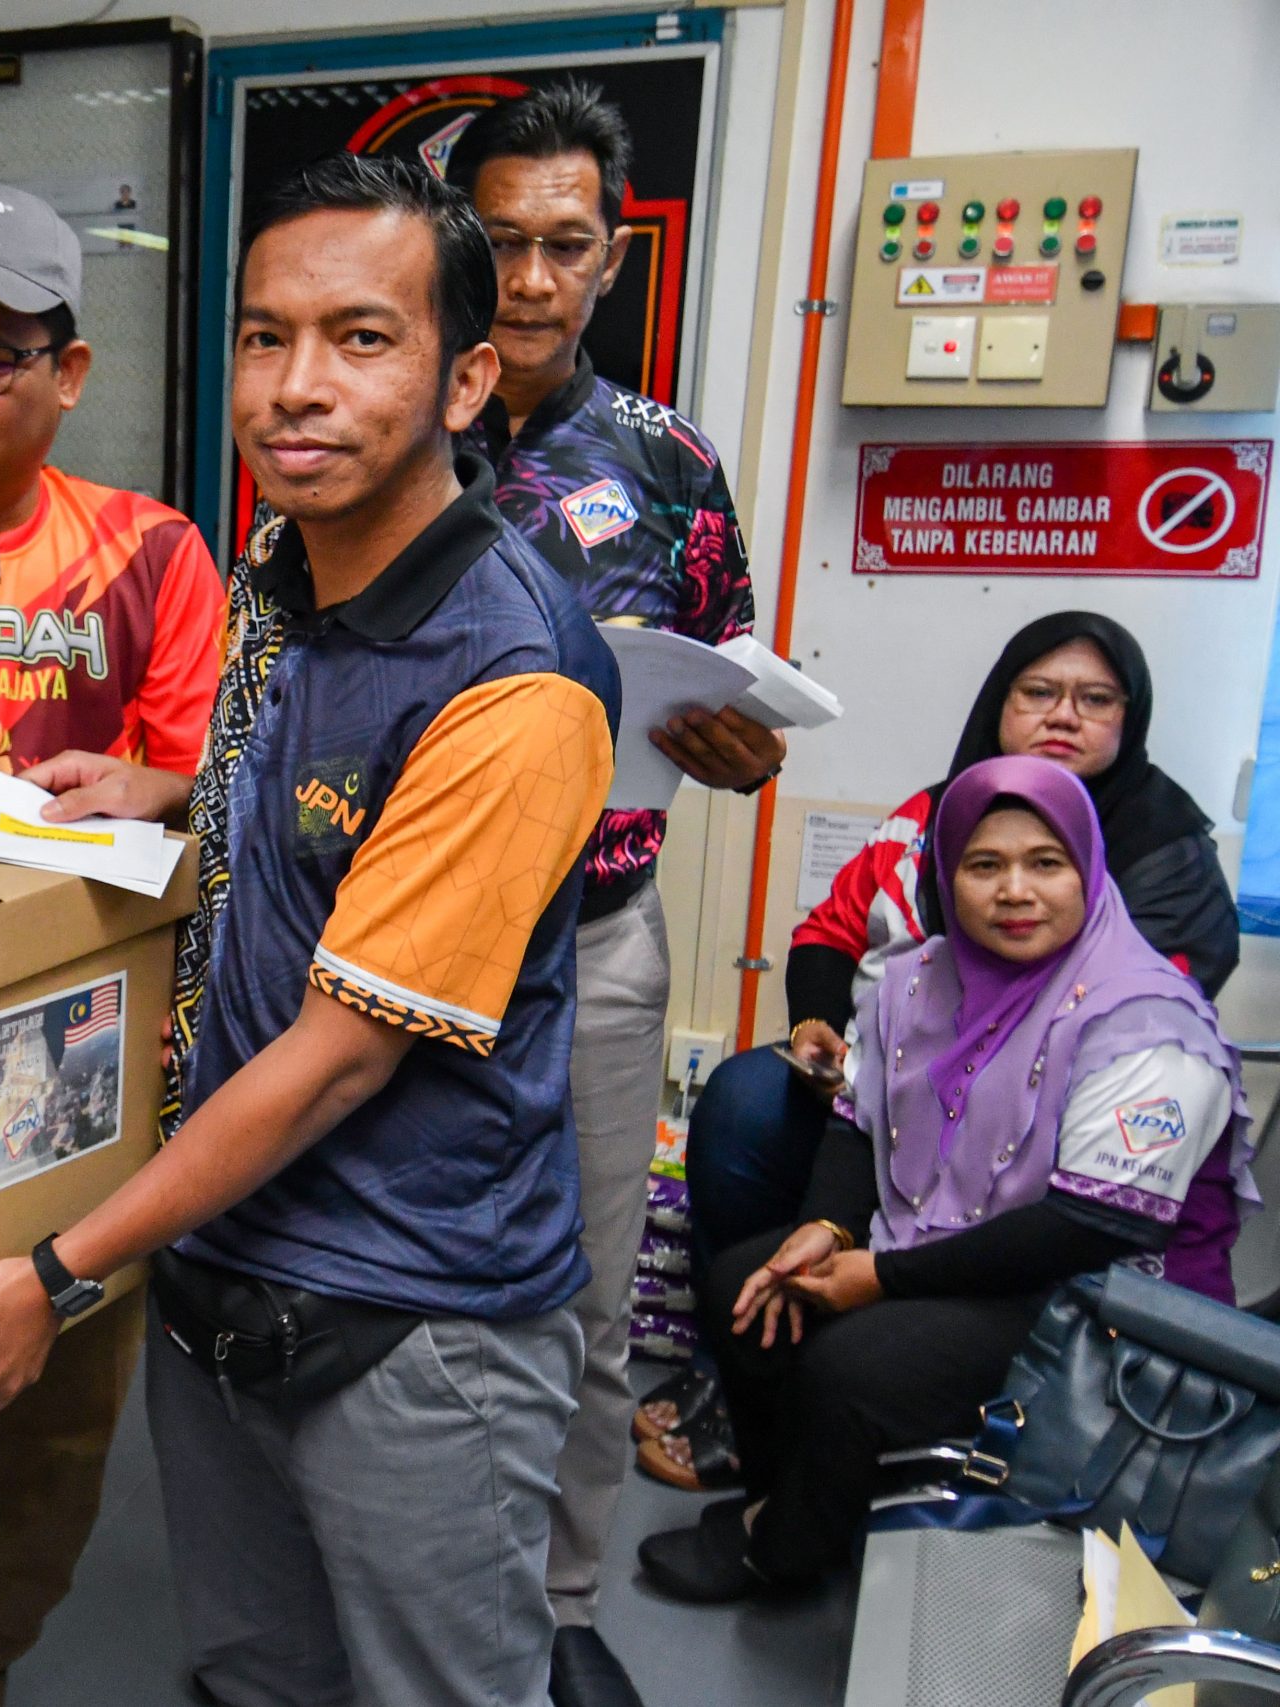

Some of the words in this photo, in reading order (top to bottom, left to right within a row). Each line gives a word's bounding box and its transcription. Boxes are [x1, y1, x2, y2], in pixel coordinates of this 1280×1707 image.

[942, 463, 1053, 489] DILARANG
[571, 502, 629, 522] JPN
[883, 496, 1007, 522] MENGAMBIL
[1017, 496, 1111, 522] GAMBAR
[891, 529, 955, 555] TANPA
[964, 530, 1097, 556] KEBENARAN
[295, 778, 366, 836] JPN
[5, 1115, 40, 1138] JPN
[1122, 1114, 1184, 1138] JPN
[1095, 1152, 1119, 1167] JPN
